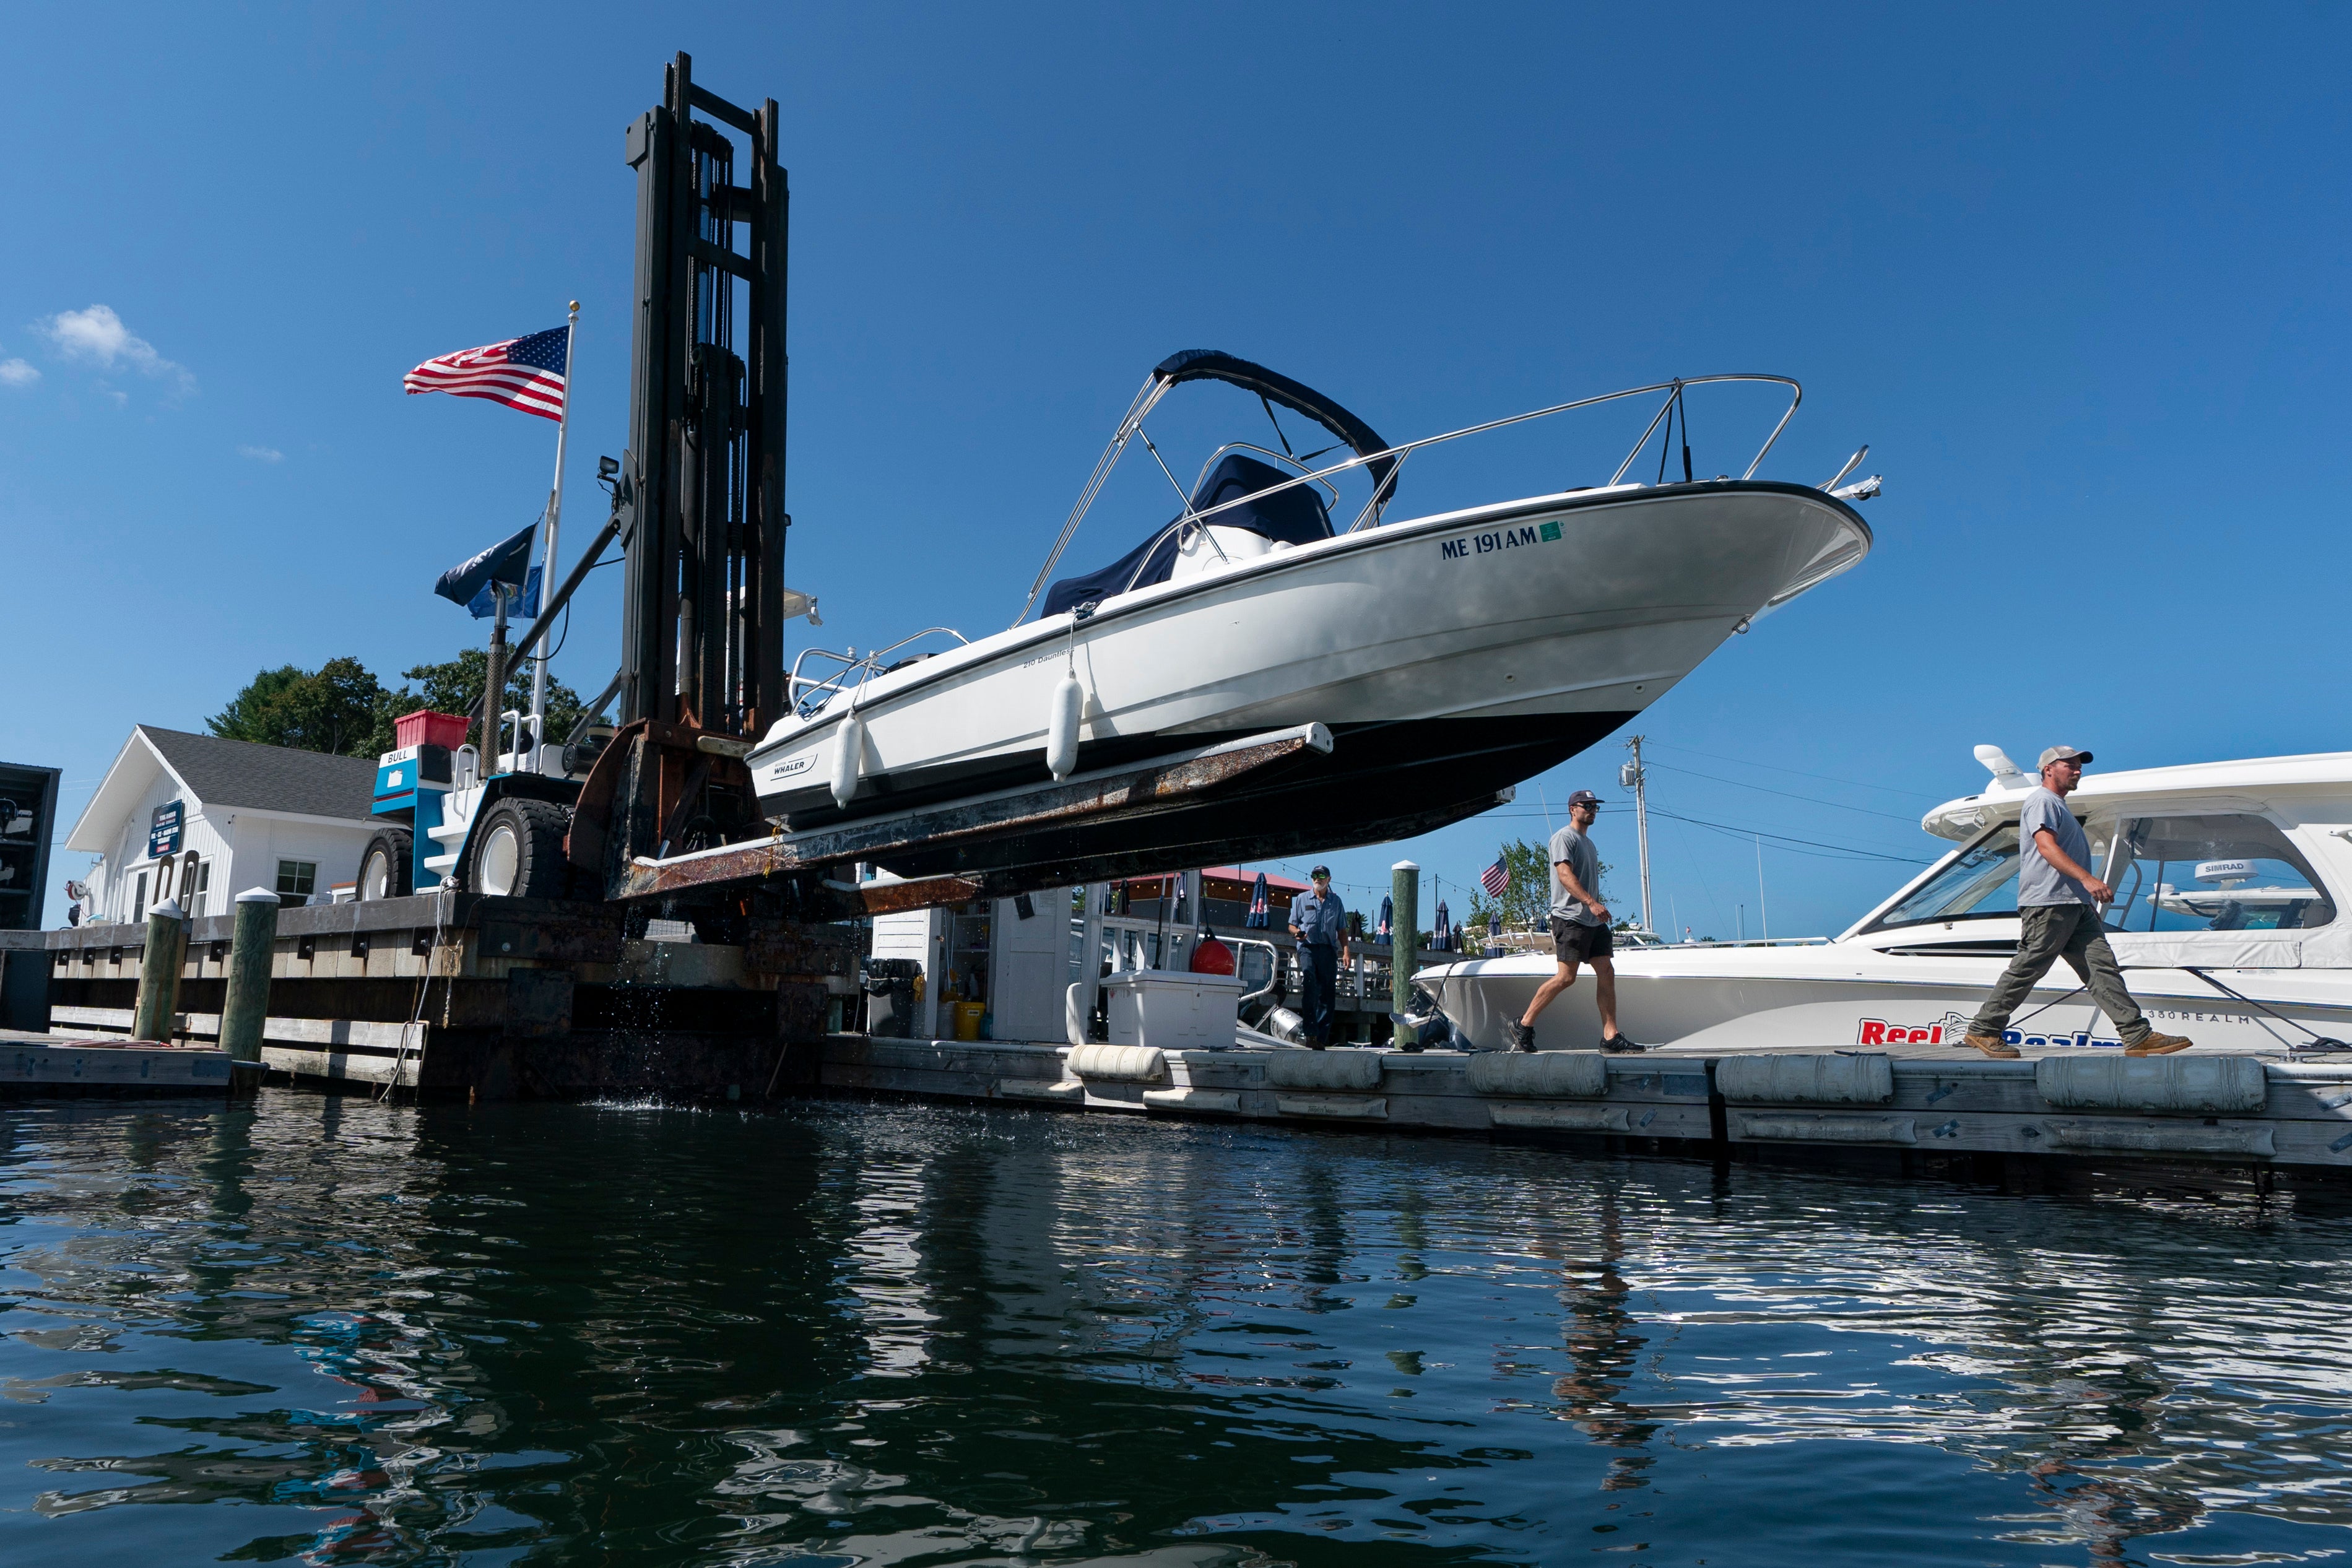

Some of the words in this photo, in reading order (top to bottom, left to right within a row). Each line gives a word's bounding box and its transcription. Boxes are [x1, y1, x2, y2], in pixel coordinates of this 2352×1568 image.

[1441, 538, 1469, 560] ME
[1473, 531, 1502, 553] 191
[1506, 526, 1537, 548] AM
[1023, 659, 1036, 669] 210
[1038, 648, 1074, 664] Dauntless
[388, 750, 407, 763] BULL
[775, 761, 804, 774] WHALER
[2205, 863, 2244, 872] SIMRAD
[2148, 1010, 2175, 1019] 350
[2182, 1012, 2249, 1024] REALM
[1861, 1021, 1942, 1045] Reel
